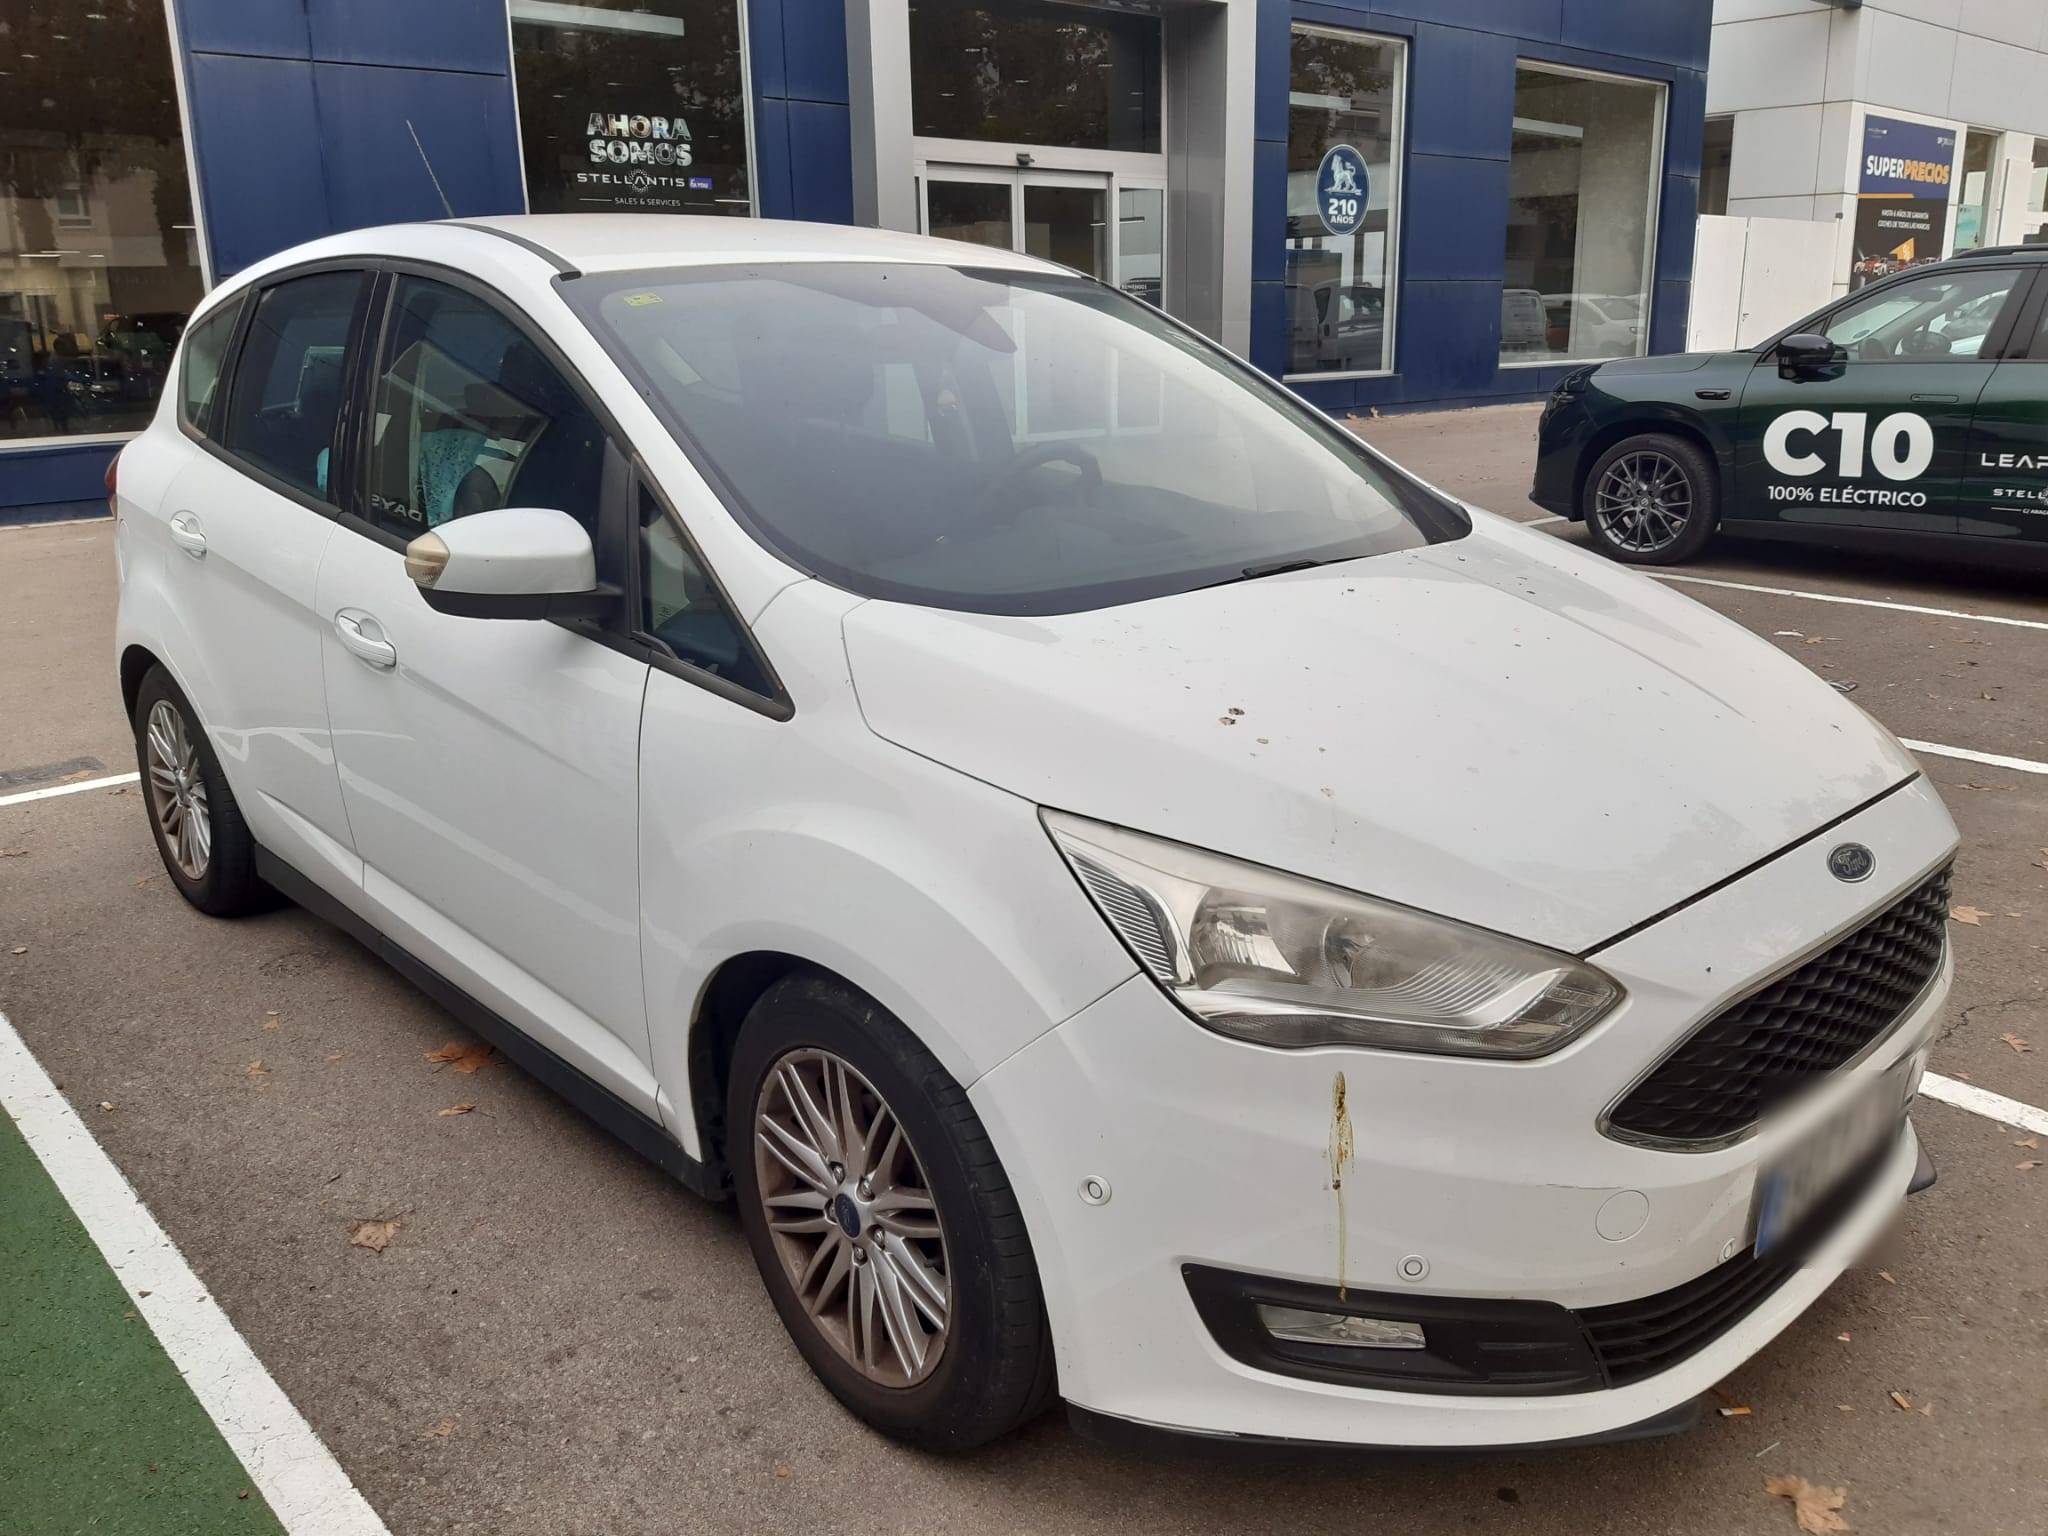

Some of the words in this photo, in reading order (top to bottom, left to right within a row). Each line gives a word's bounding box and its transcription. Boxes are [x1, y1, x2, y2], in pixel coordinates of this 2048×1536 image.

[586, 112, 692, 141] AHORA
[589, 139, 693, 167] SOMOS
[576, 172, 685, 188] STELLANTIS
[1866, 155, 1950, 185] SUPERPRECIOS
[614, 197, 638, 206] SALES
[647, 198, 681, 207] SERVICES
[1328, 198, 1358, 216] 210
[1330, 214, 1354, 225] AÑOS
[1763, 409, 1934, 481] C10
[1768, 485, 1814, 501] 100%
[1819, 485, 1927, 507] ELÉCTRICO
